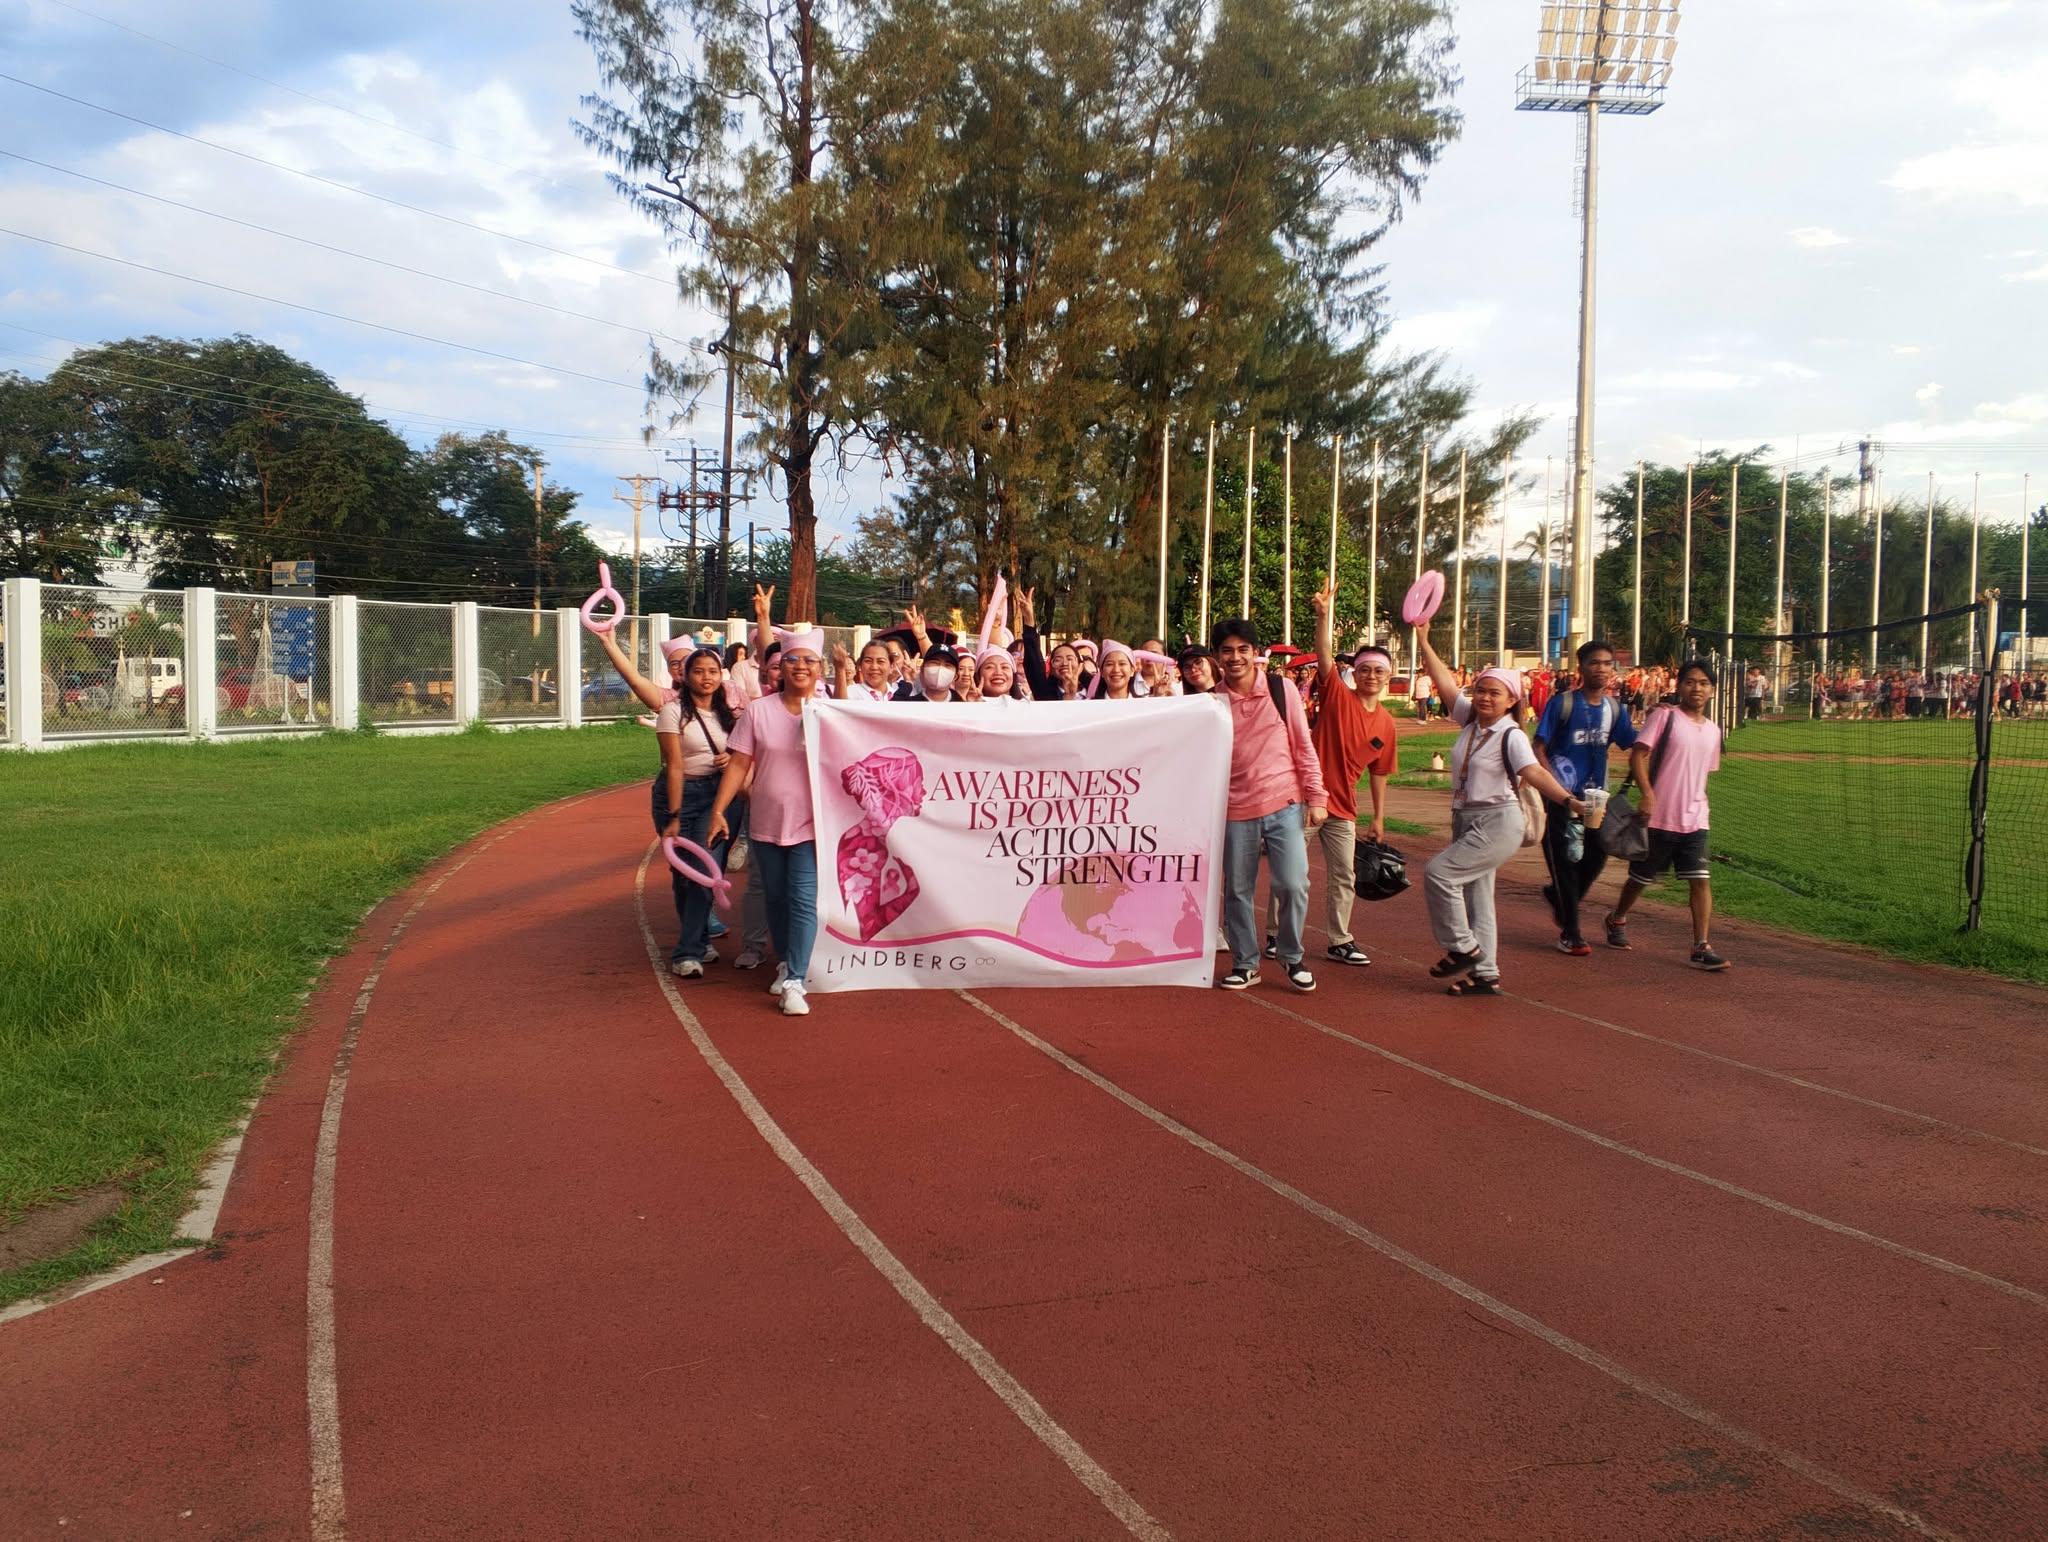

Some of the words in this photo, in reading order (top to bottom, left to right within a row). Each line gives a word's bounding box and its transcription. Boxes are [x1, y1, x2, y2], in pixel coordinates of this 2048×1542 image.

[121, 563, 137, 574] SPA
[928, 767, 1141, 801] AWARENESS
[968, 801, 998, 830] IS
[1005, 797, 1132, 828] POWER
[985, 825, 1120, 857] ACTION
[1129, 825, 1157, 854] IS
[1015, 854, 1202, 887] STRENGTH
[827, 950, 967, 974] LINDBERG
